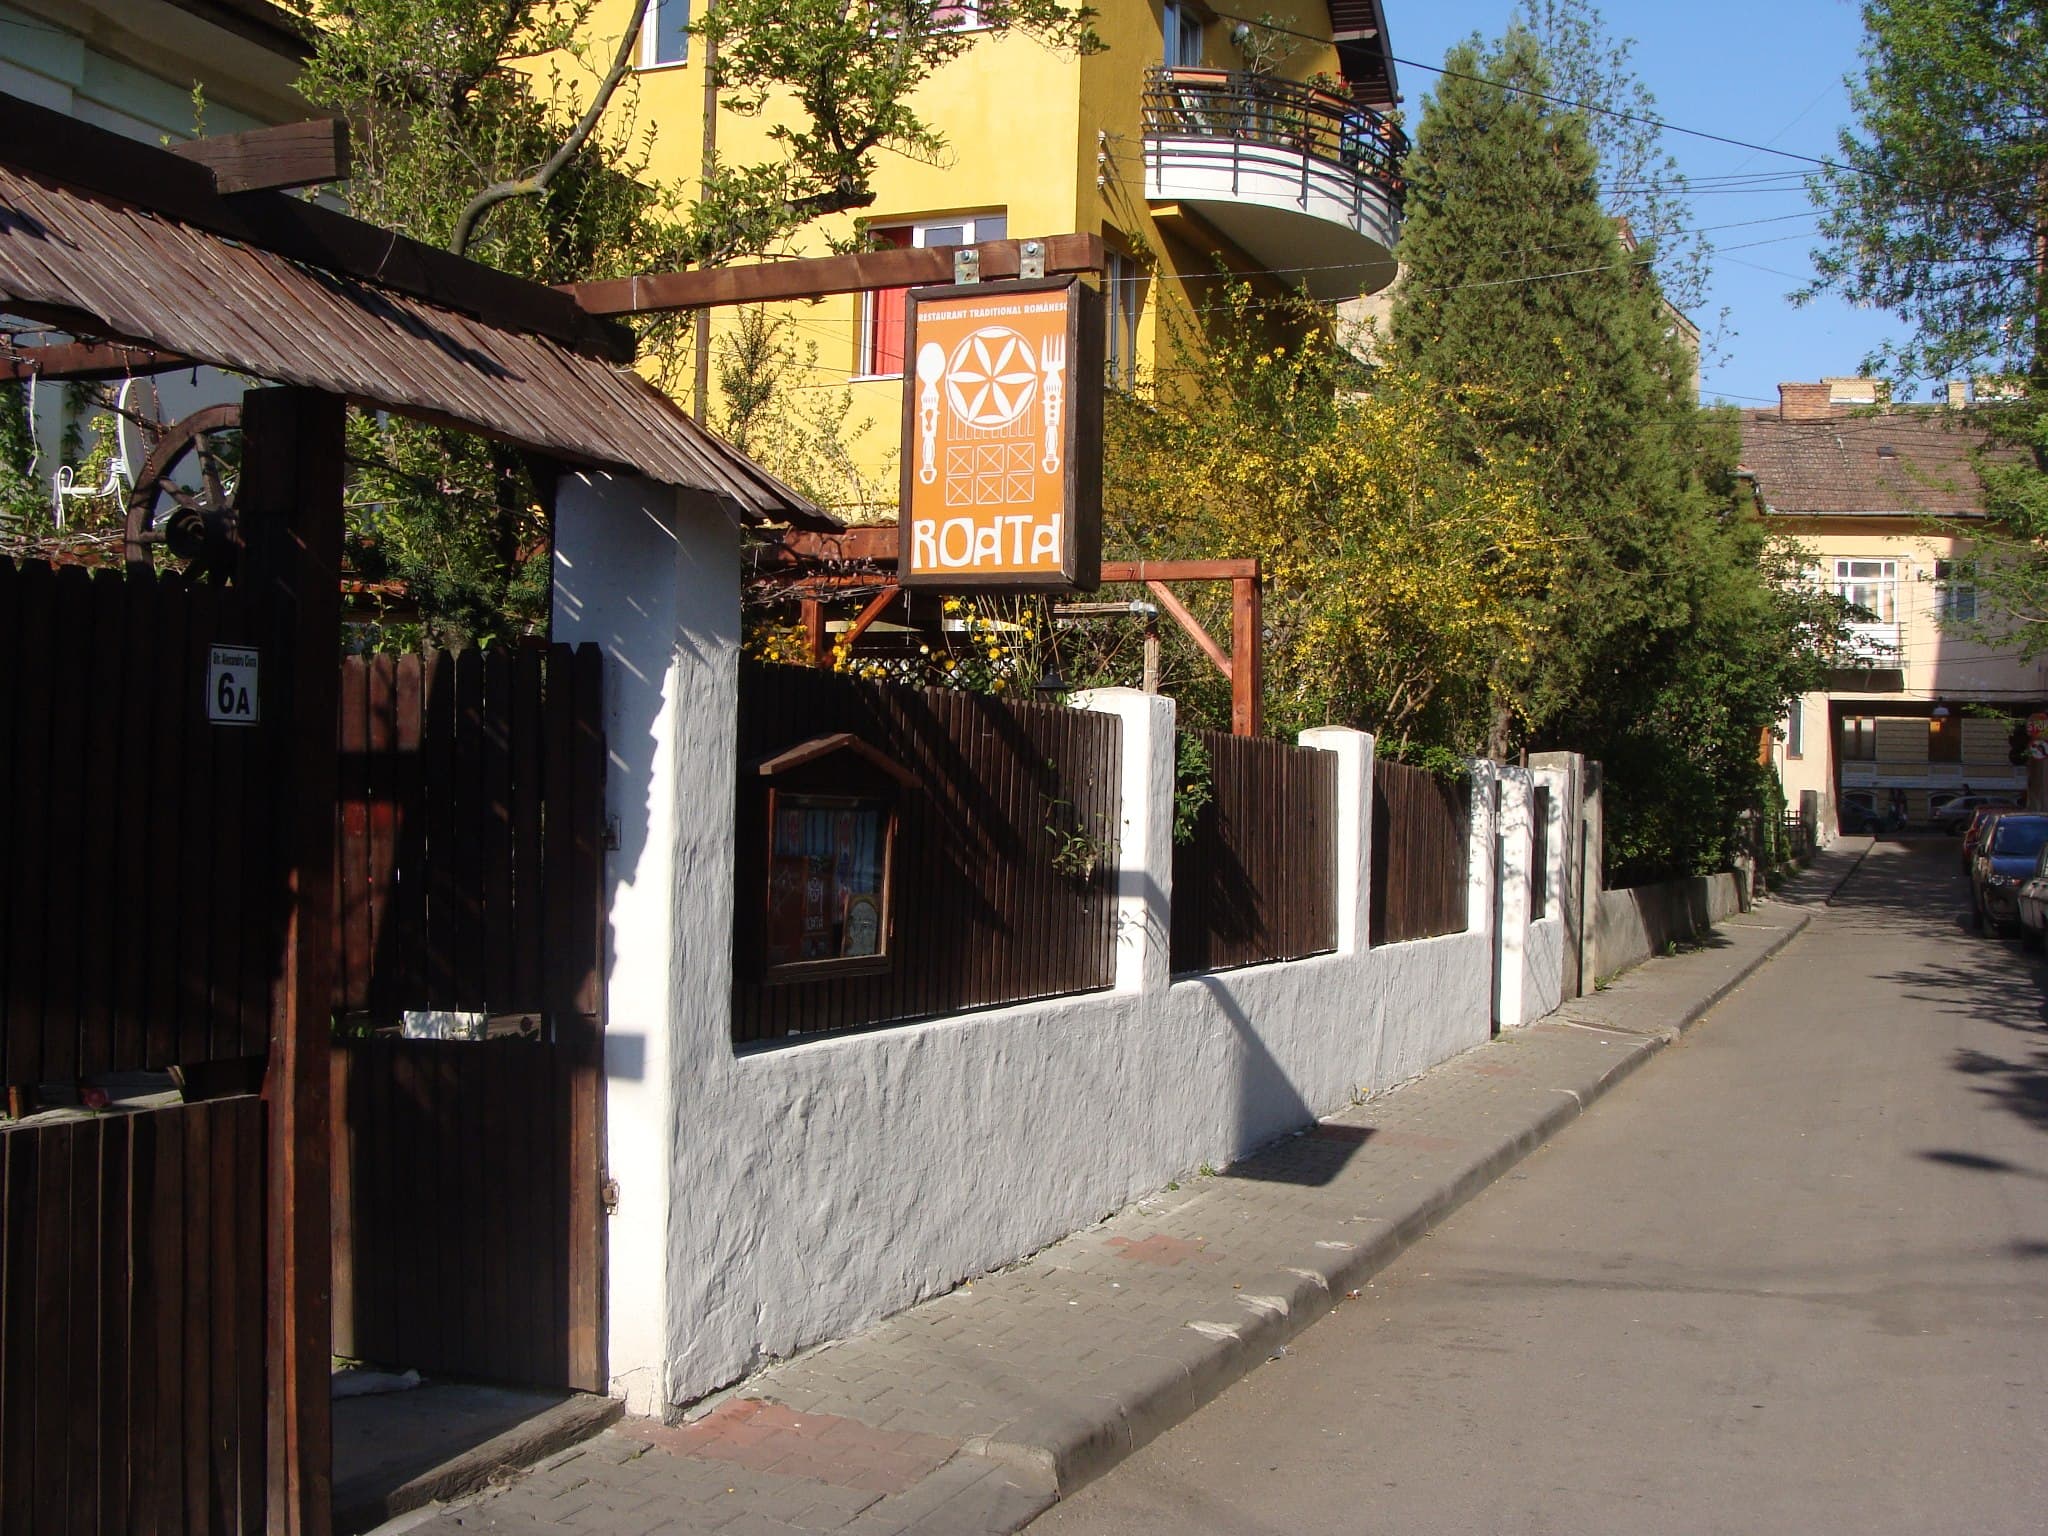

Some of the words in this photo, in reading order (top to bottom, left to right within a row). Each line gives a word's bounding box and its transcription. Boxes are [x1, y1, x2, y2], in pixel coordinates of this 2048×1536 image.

[918, 310, 967, 322] RESTAURANT
[970, 306, 1021, 318] TRADITIONAL
[218, 672, 250, 714] 6A
